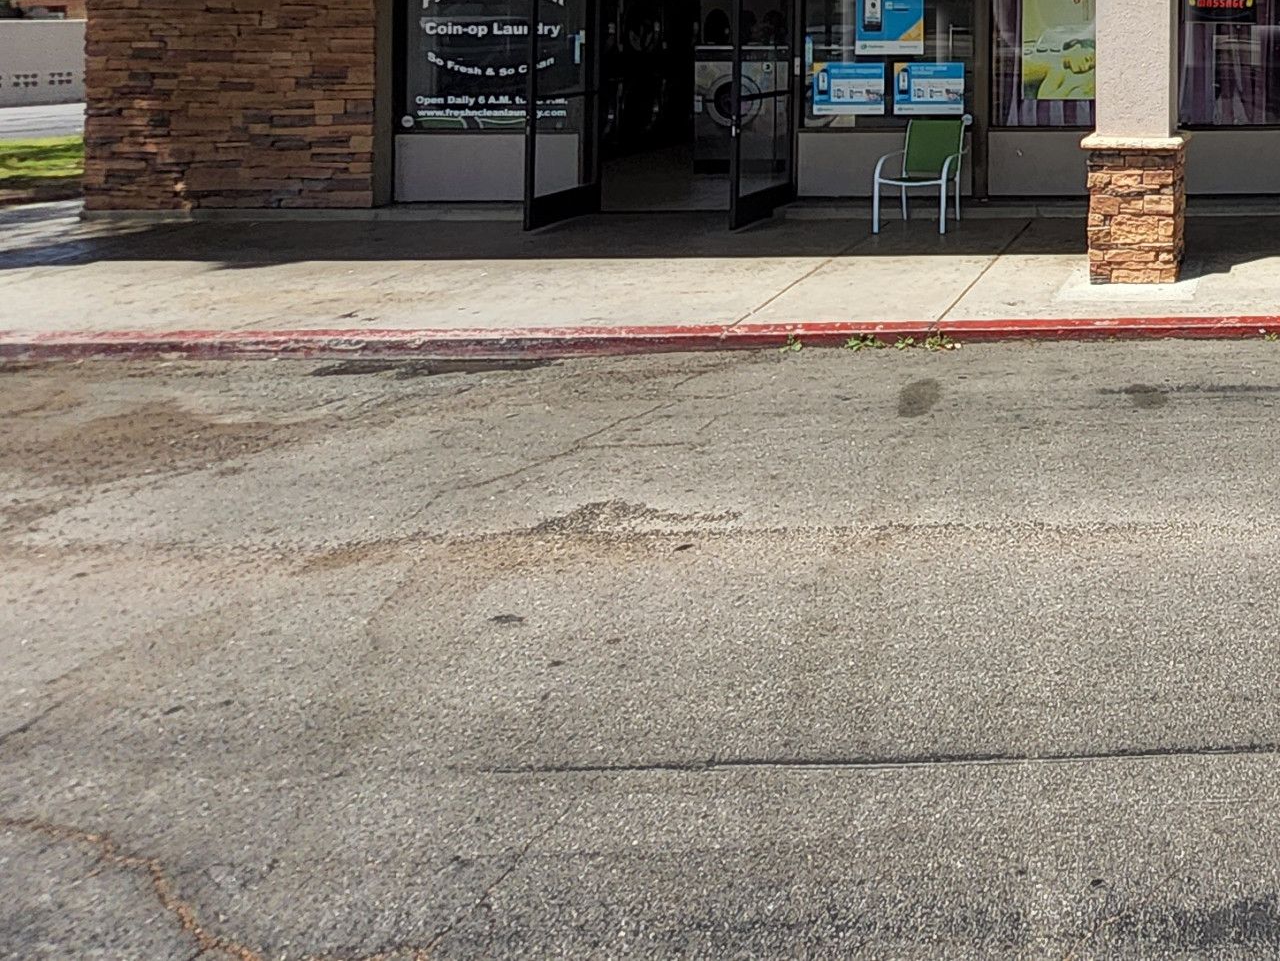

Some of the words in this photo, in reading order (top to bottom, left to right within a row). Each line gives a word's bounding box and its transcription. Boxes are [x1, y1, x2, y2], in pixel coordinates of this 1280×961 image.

[425, 22, 488, 37] Coin-op
[427, 51, 444, 66] So
[447, 60, 482, 75] Fresh
[485, 68, 495, 76] &
[499, 67, 515, 76] So
[518, 56, 555, 74] Can
[415, 95, 444, 105] Open
[447, 95, 476, 106] Daily
[478, 95, 486, 104] 6
[416, 108, 567, 120] www.freshncleanlauny.com
